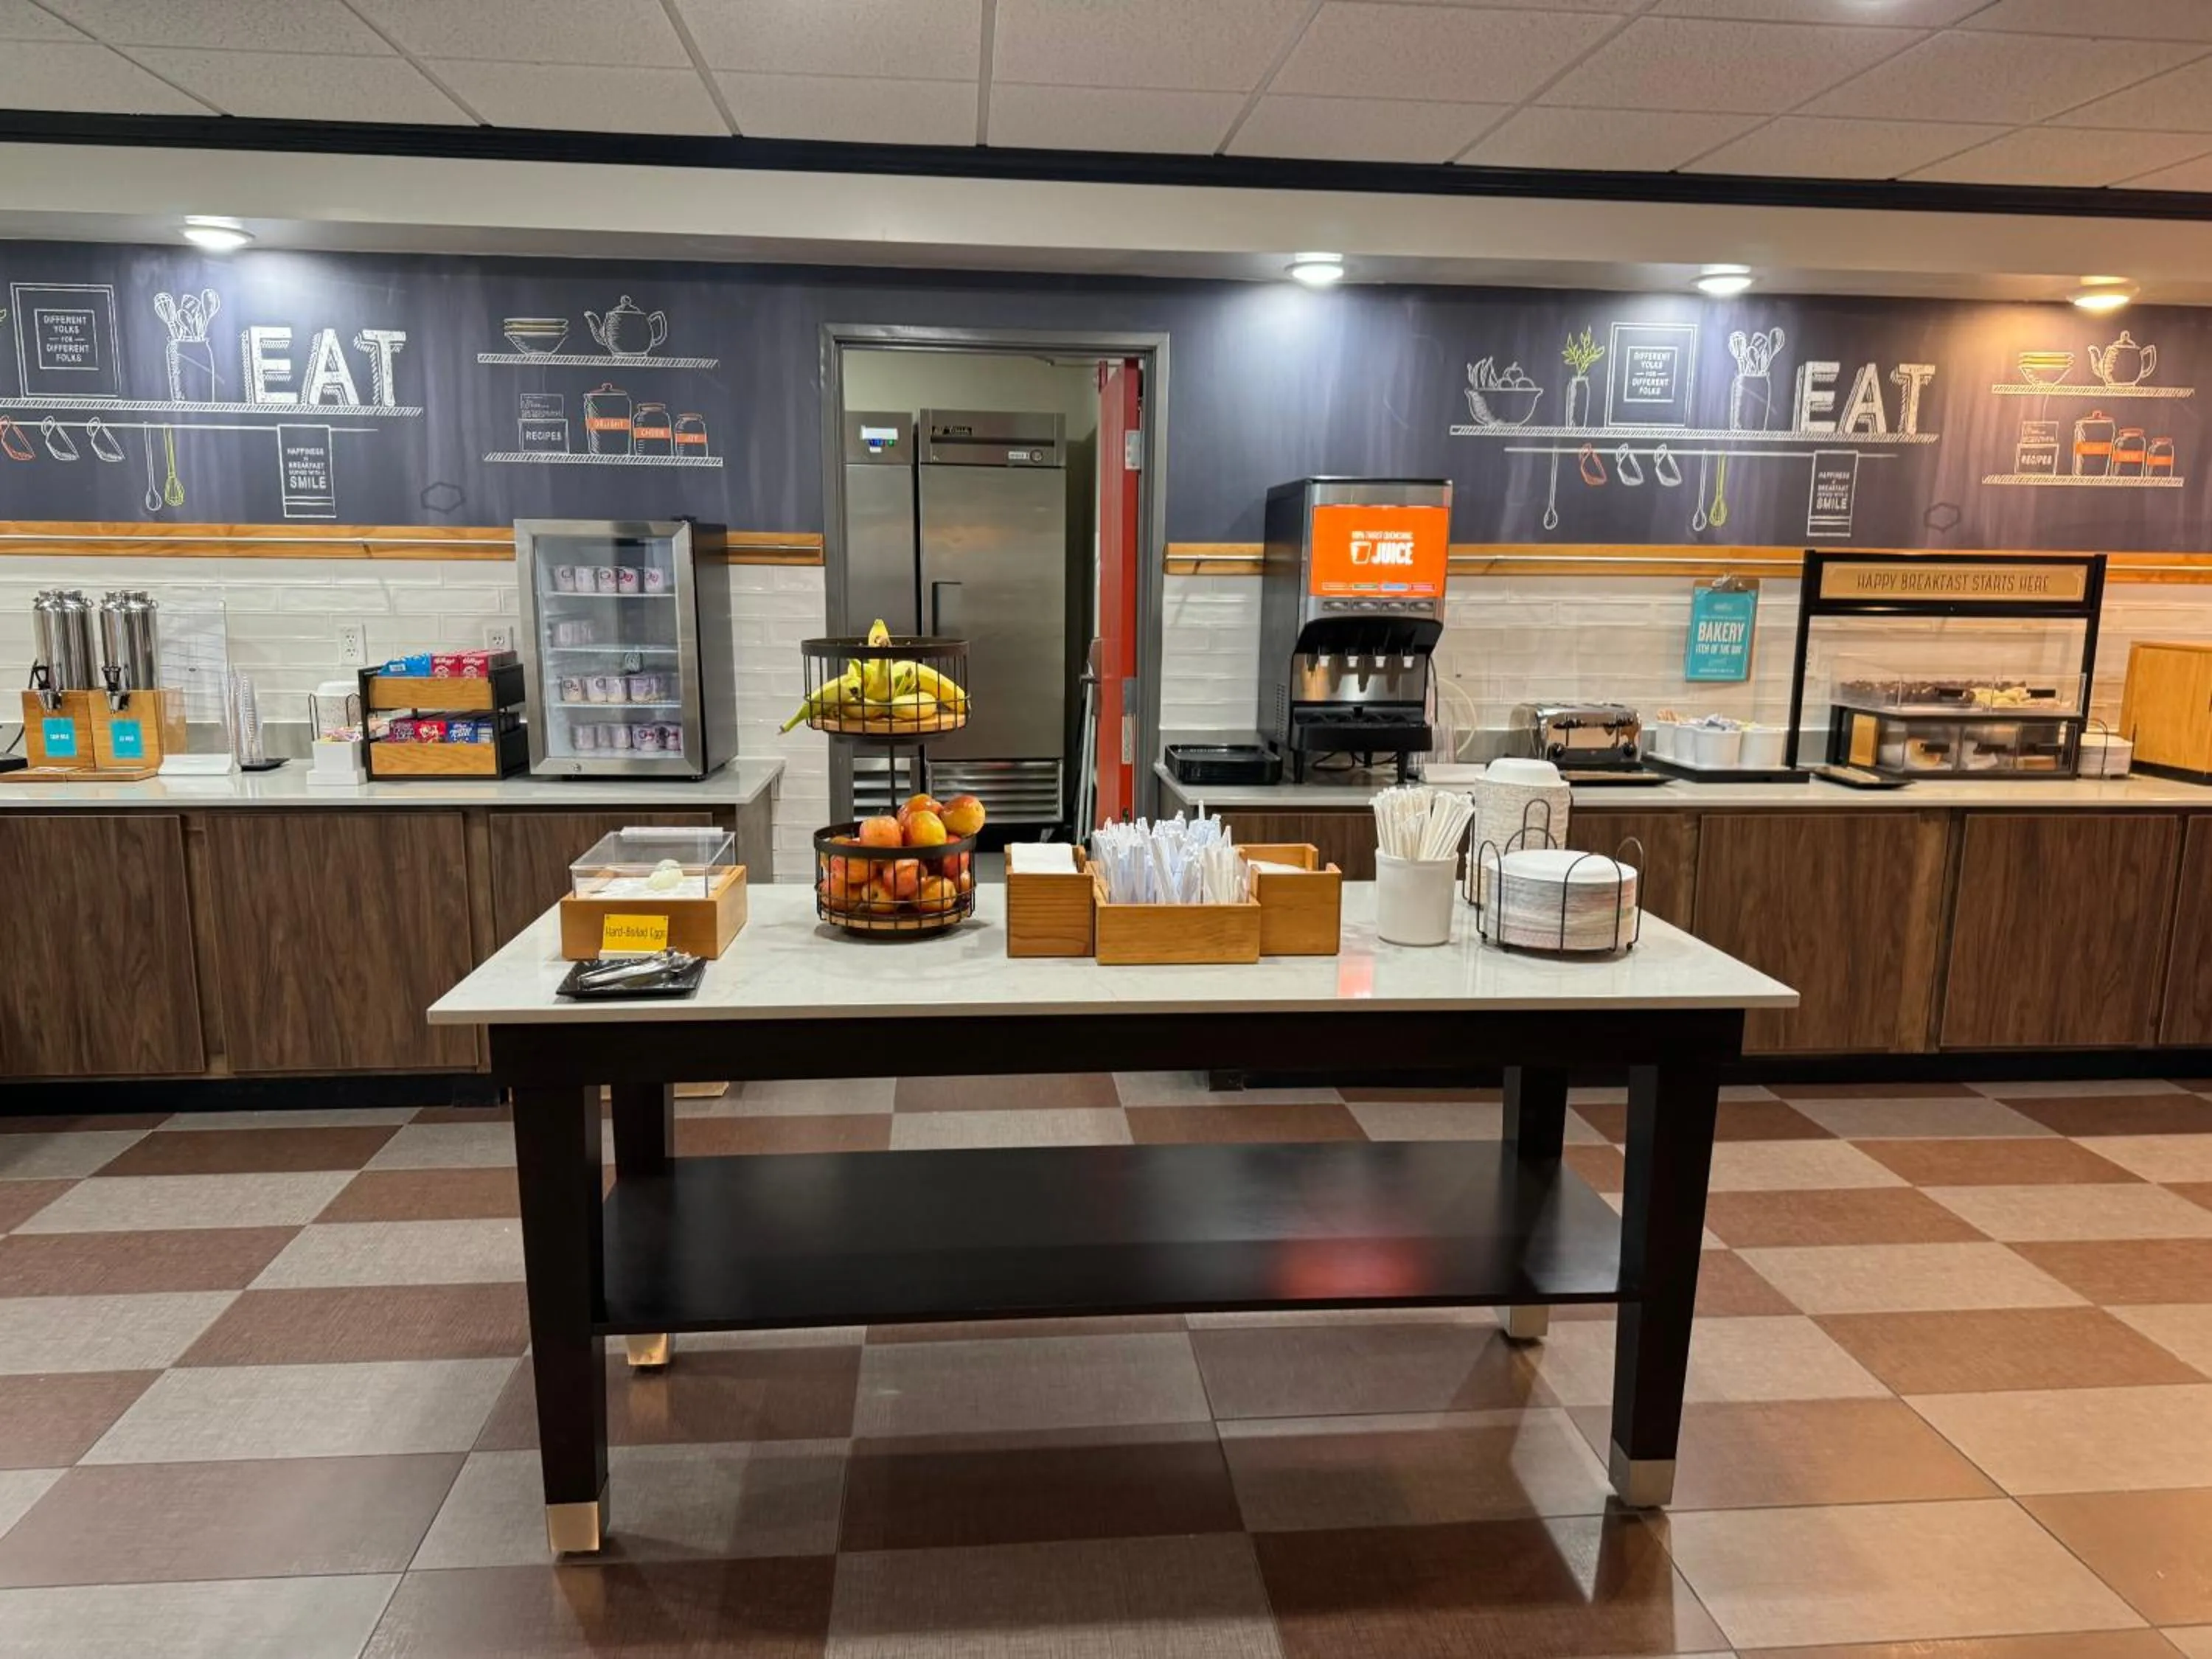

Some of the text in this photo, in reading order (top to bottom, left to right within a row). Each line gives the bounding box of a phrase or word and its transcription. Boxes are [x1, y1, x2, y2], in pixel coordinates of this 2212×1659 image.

[44, 315, 87, 324] DIFFERENT
[54, 325, 80, 334] YOLKS
[46, 344, 89, 353] DIFFERENT
[56, 354, 82, 363] FOLKS
[241, 326, 406, 408] EAT
[1792, 361, 1936, 434] EAT
[526, 431, 562, 442] RECIPES
[2020, 453, 2053, 465] RECIPES
[290, 476, 327, 490] SMILE
[1816, 497, 1848, 510] SMILE
[1371, 541, 1415, 566] JUICE
[1857, 572, 2051, 593] HAPPY BREAKFAST STARTS HERE
[1697, 621, 1745, 643] BAKERY
[605, 925, 648, 937] Hard-Boiled
